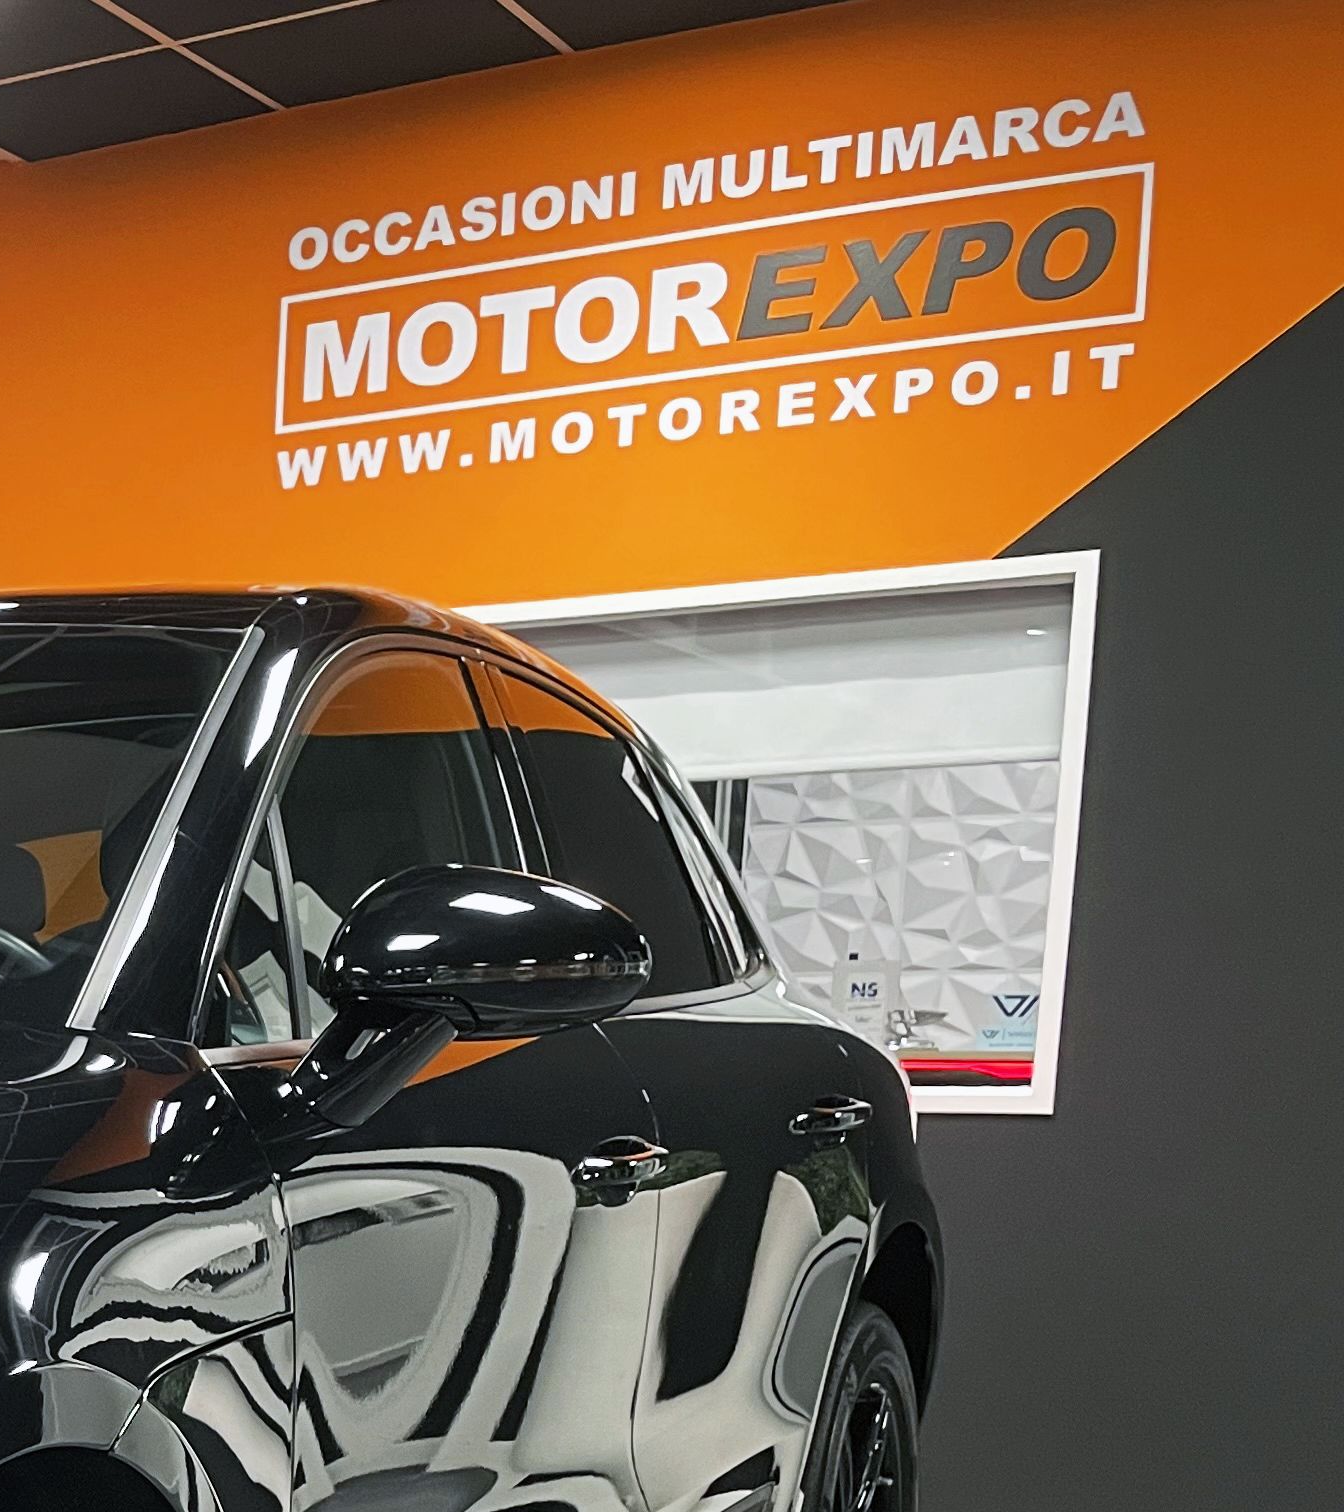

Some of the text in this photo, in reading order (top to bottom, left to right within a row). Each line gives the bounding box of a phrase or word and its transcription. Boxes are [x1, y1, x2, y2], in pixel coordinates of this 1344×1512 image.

[288, 90, 1146, 272] OCCASIONI MULTIMARCA
[302, 206, 1118, 403] MOTOREXPO
[277, 343, 1136, 490] WWW.MOTOREXPO.IT
